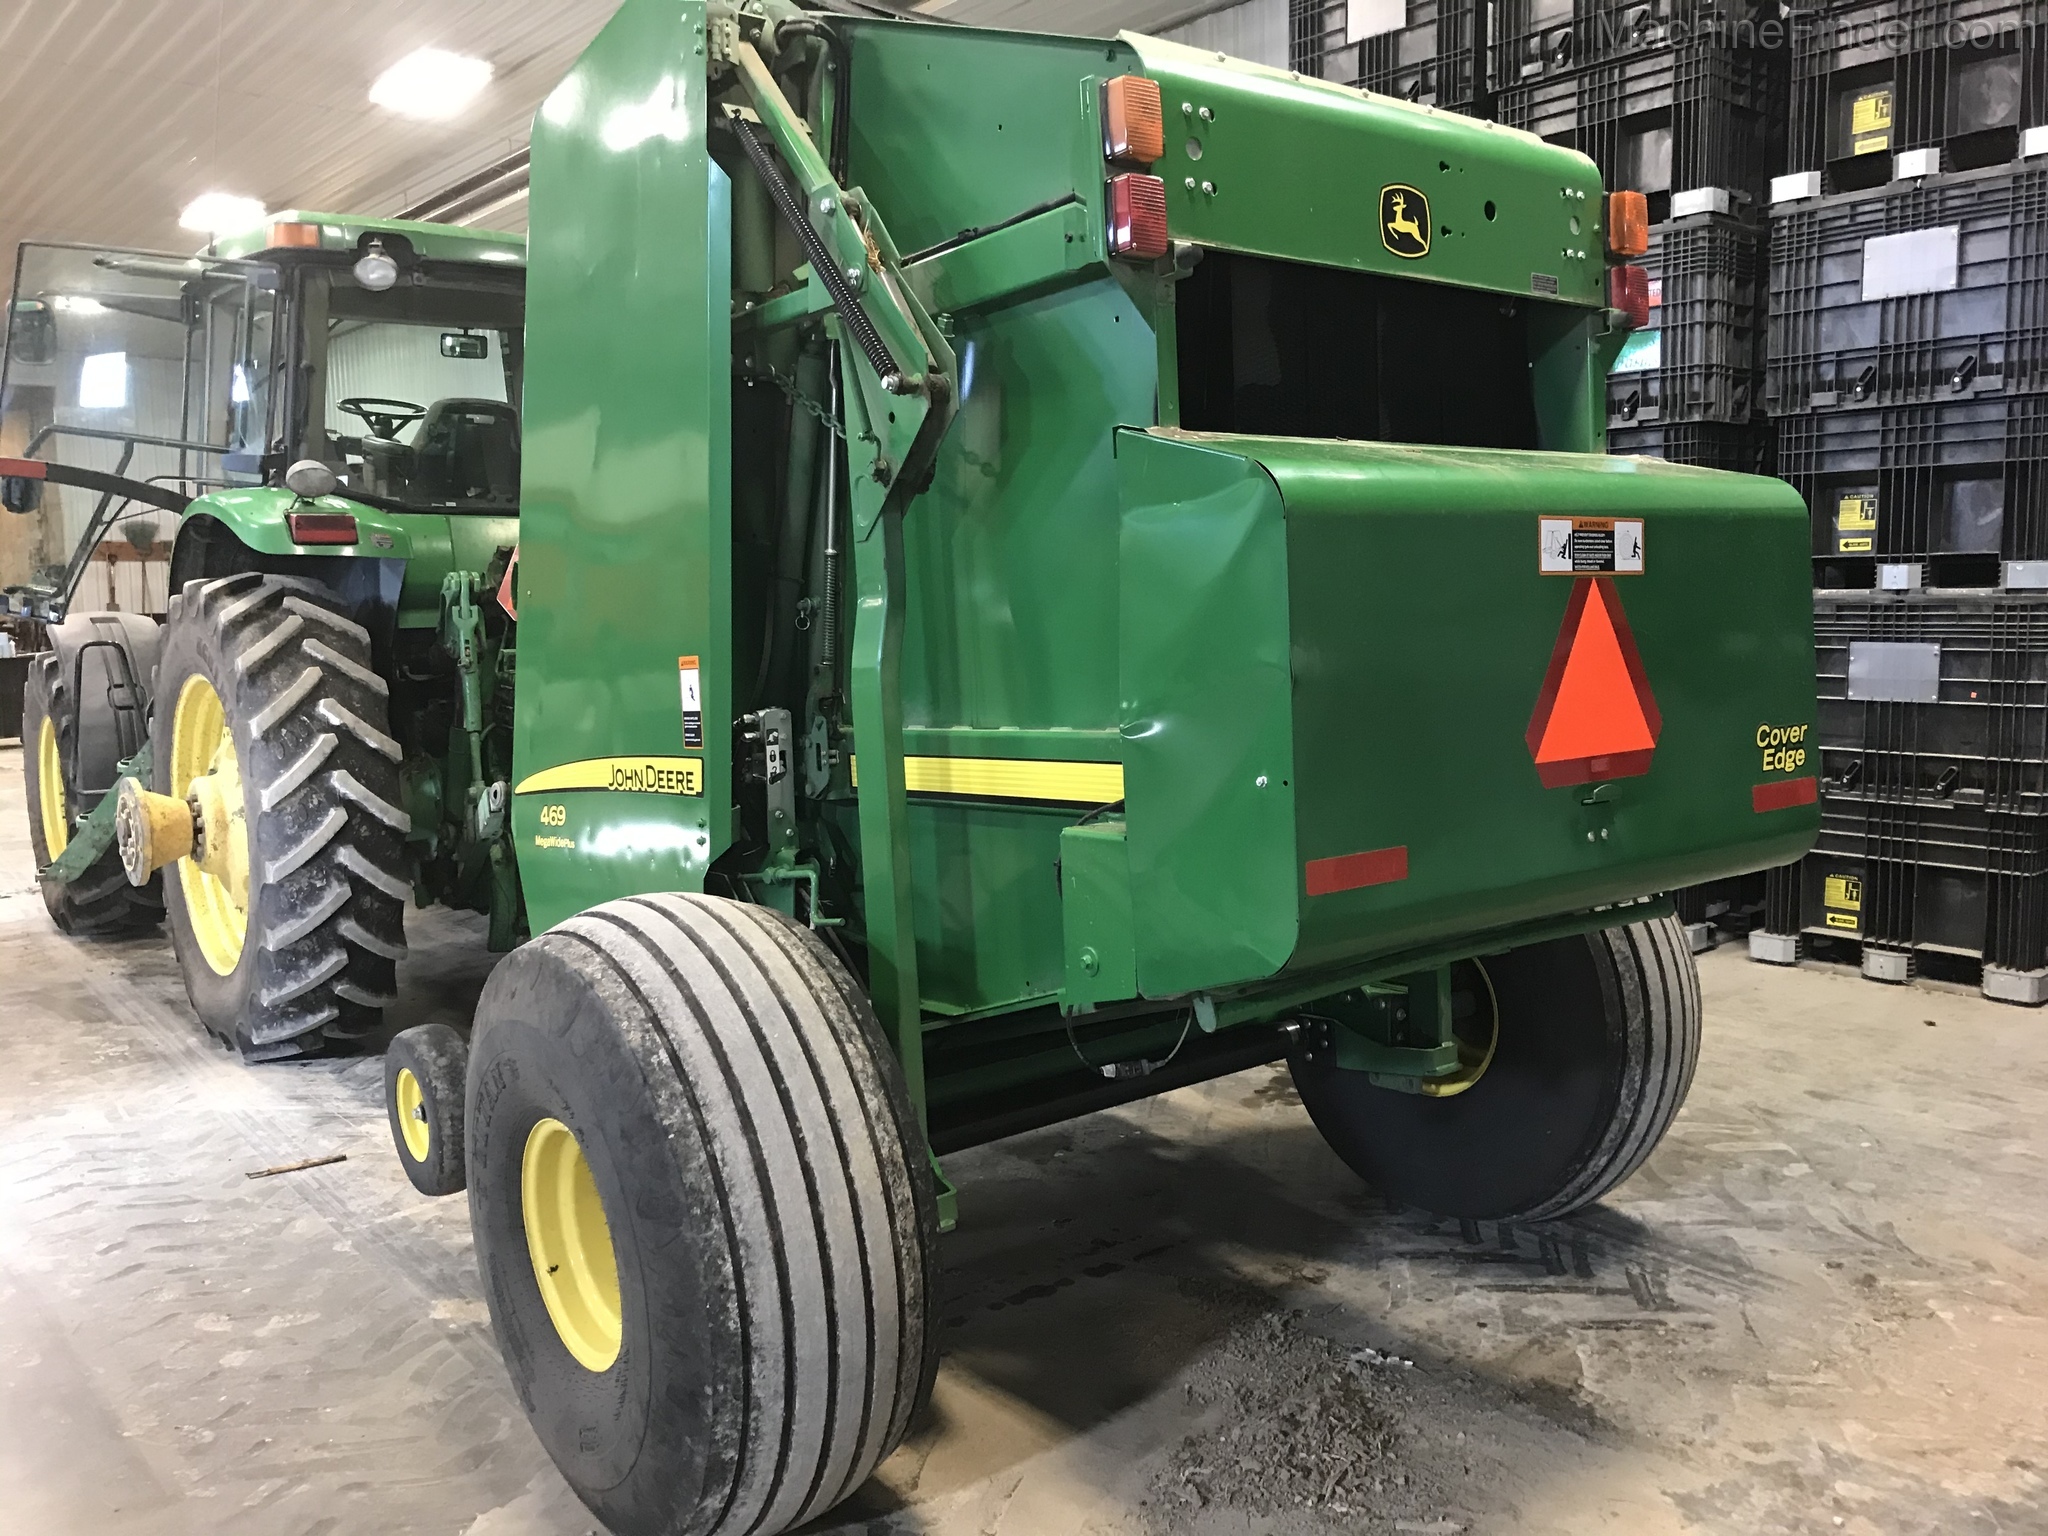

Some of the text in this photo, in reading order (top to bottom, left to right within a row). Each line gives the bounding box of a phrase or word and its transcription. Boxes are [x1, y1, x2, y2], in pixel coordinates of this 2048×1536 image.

[1584, 521, 1608, 529] WARNING
[1756, 723, 1808, 748] Cover
[1762, 747, 1806, 773] Edge
[608, 764, 695, 791] JOHN DEERE
[540, 804, 567, 827] 469
[534, 834, 575, 849] MegaWidePlus
